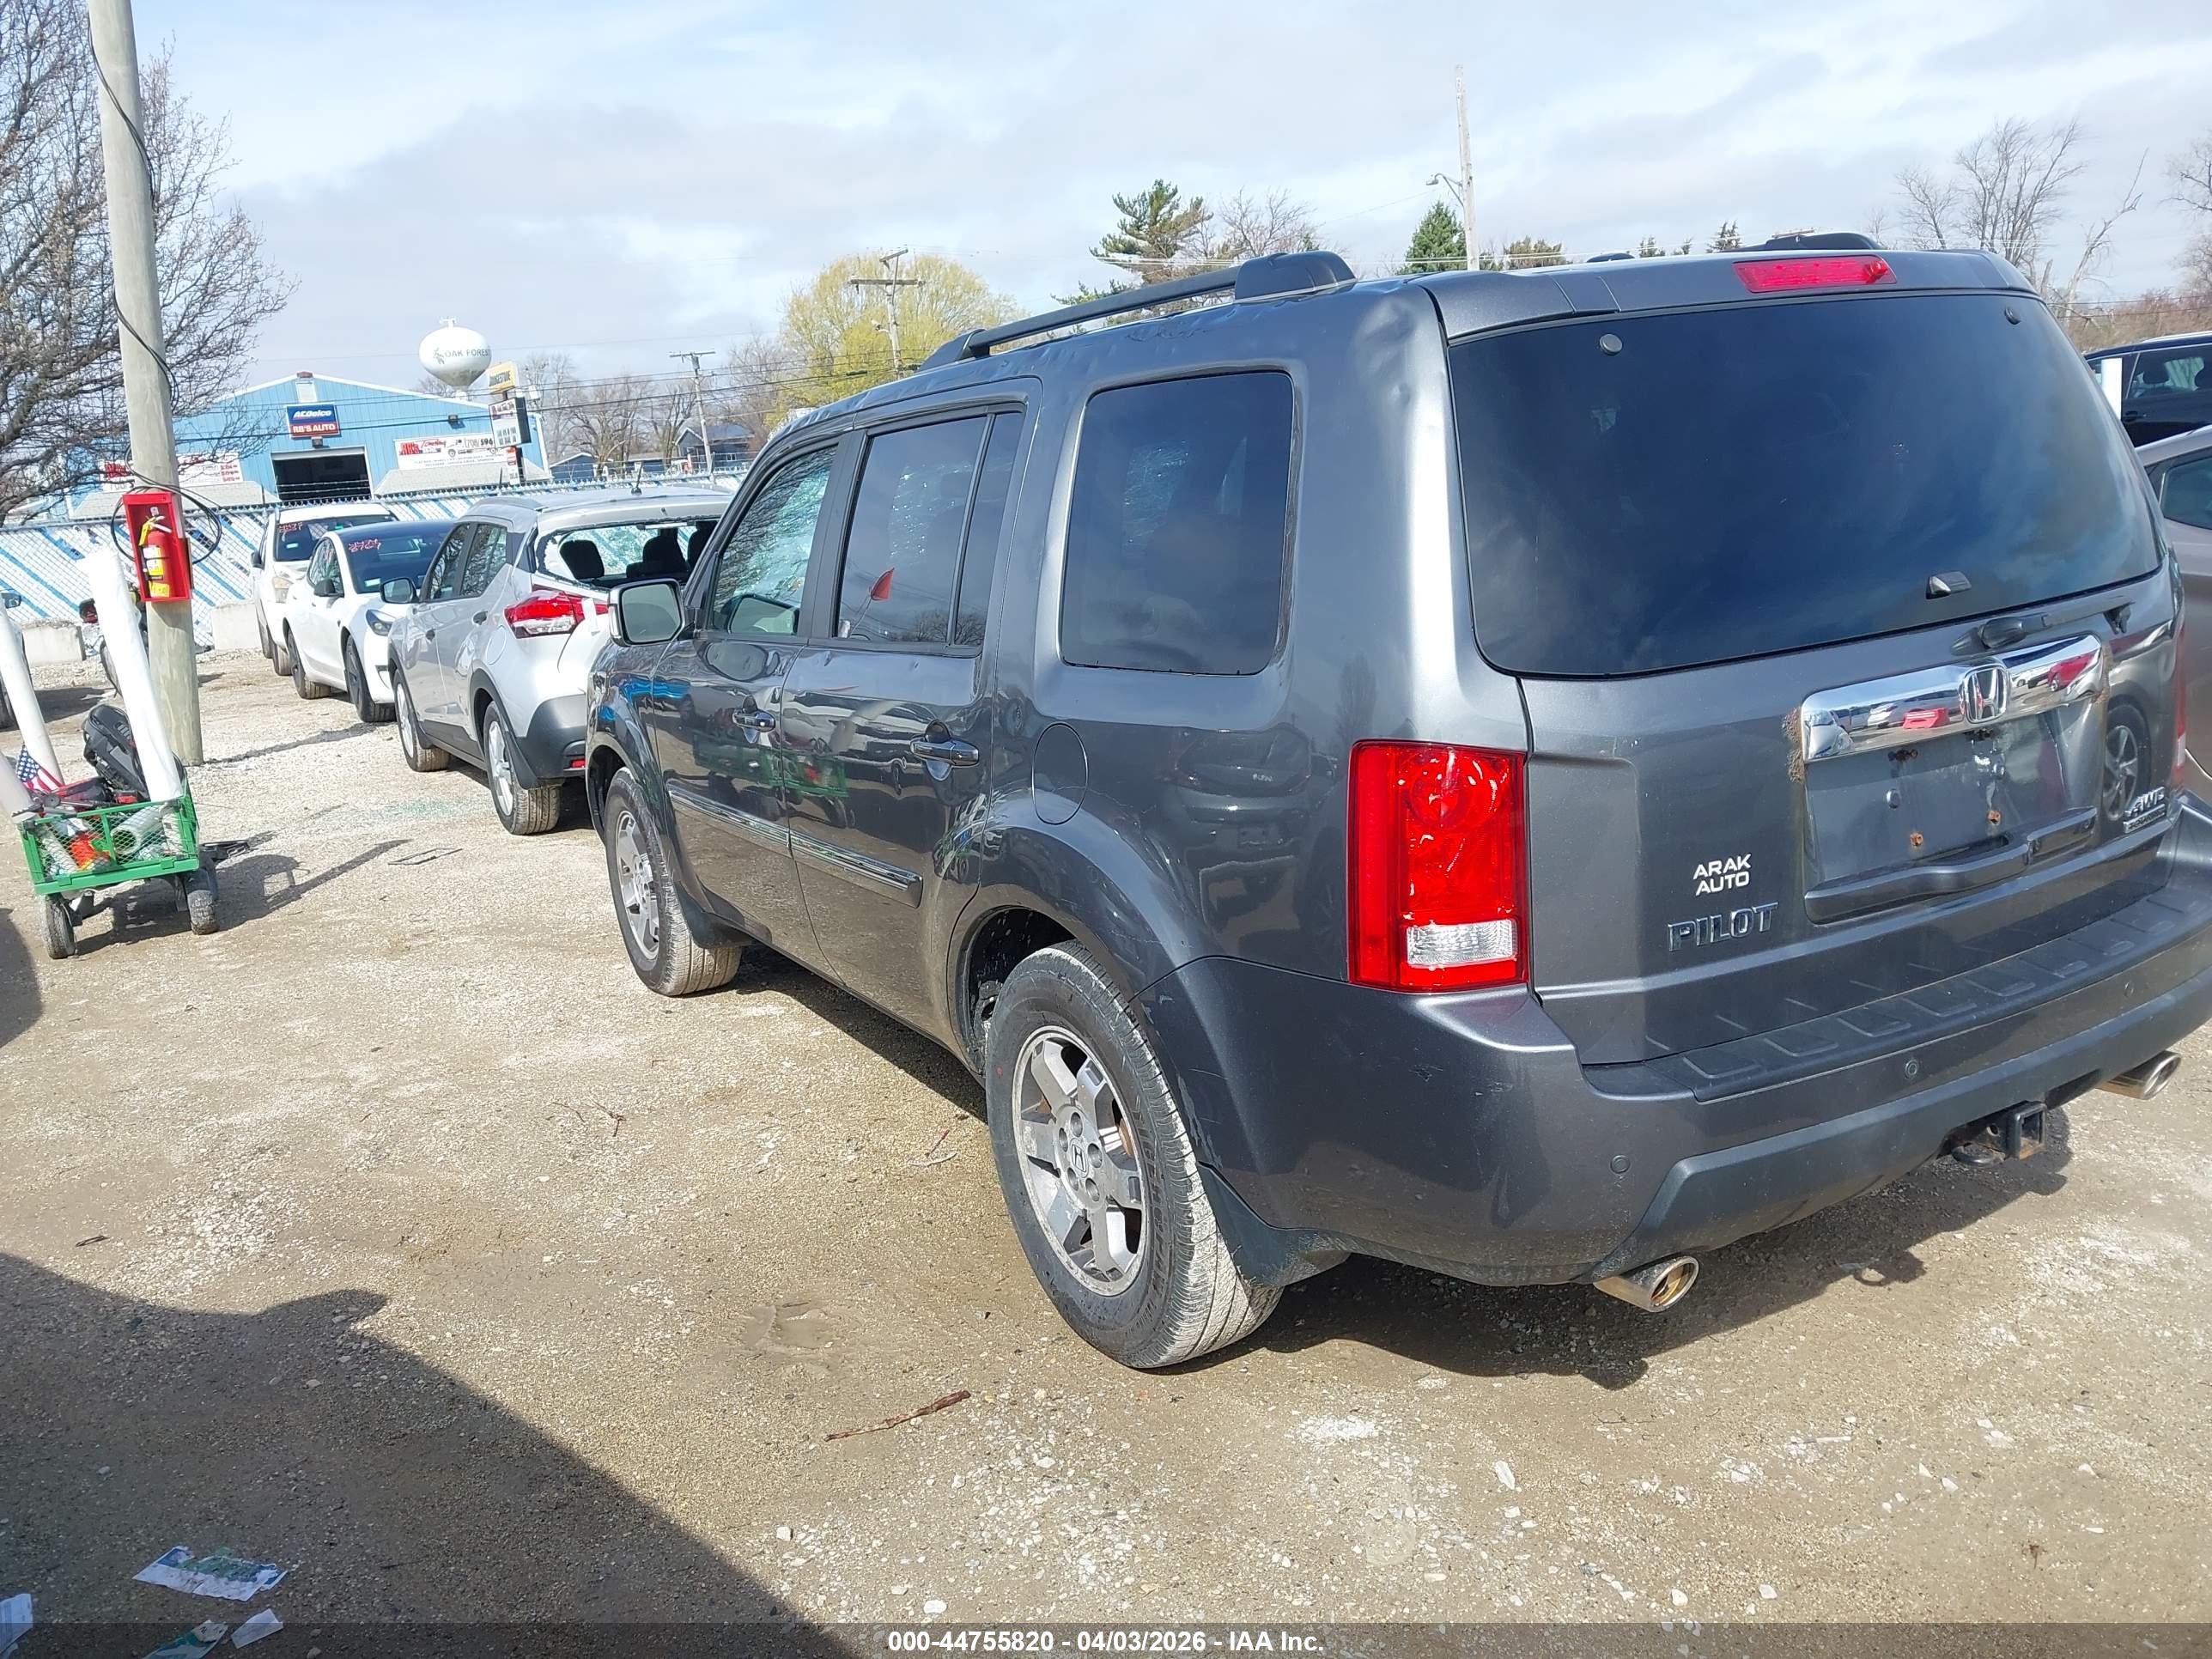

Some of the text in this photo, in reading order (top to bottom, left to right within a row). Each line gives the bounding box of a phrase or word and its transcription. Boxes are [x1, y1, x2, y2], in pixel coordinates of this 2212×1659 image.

[313, 423, 336, 432] AUTO
[1693, 854, 1752, 880] ARAK
[1695, 871, 1750, 896] AUTO
[1668, 902, 1778, 952] PILOT
